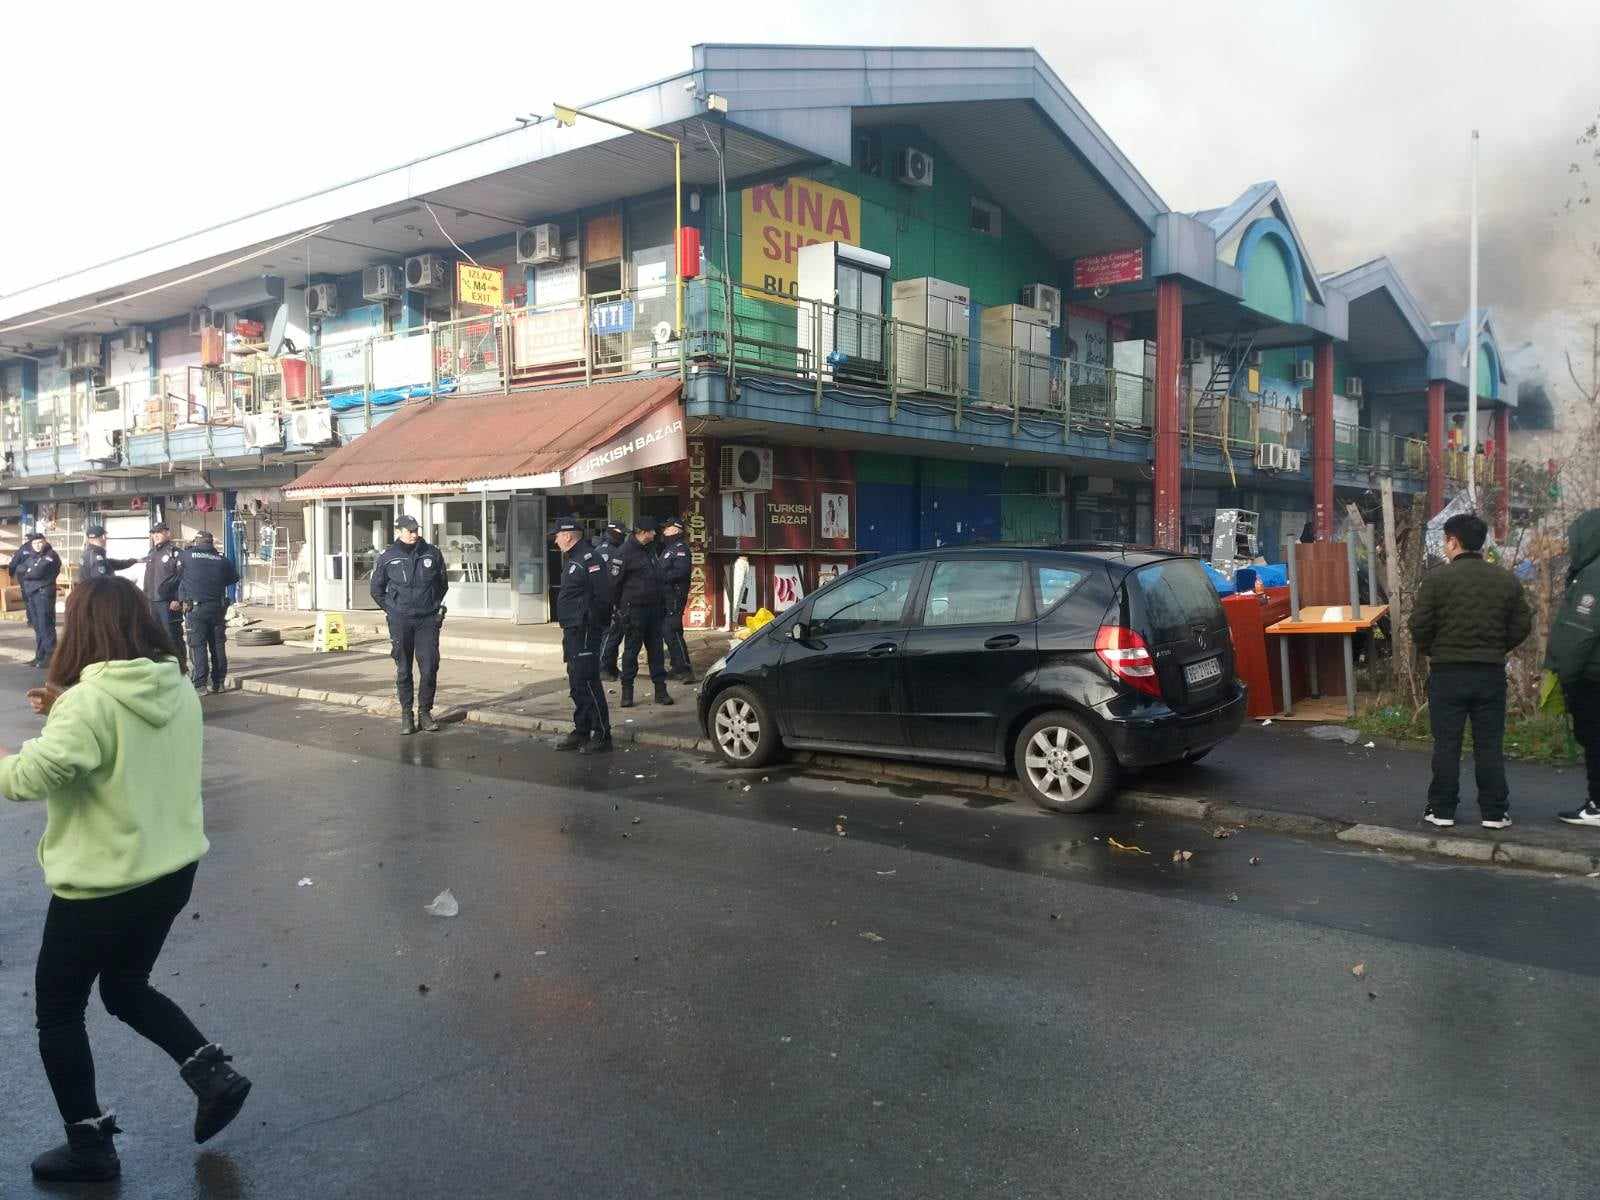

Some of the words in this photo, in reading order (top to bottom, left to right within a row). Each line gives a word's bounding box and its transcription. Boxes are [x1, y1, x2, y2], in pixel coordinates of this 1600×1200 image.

[752, 182, 851, 240] KINA
[472, 291, 490, 302] EXIT
[473, 281, 487, 291] M4
[569, 441, 634, 478] TURKISH
[635, 420, 683, 450] BAZAR
[689, 441, 706, 543] TURKISH
[767, 503, 812, 513] TURKISH
[771, 515, 808, 525] BAZAR
[690, 552, 707, 626] BAZAR
